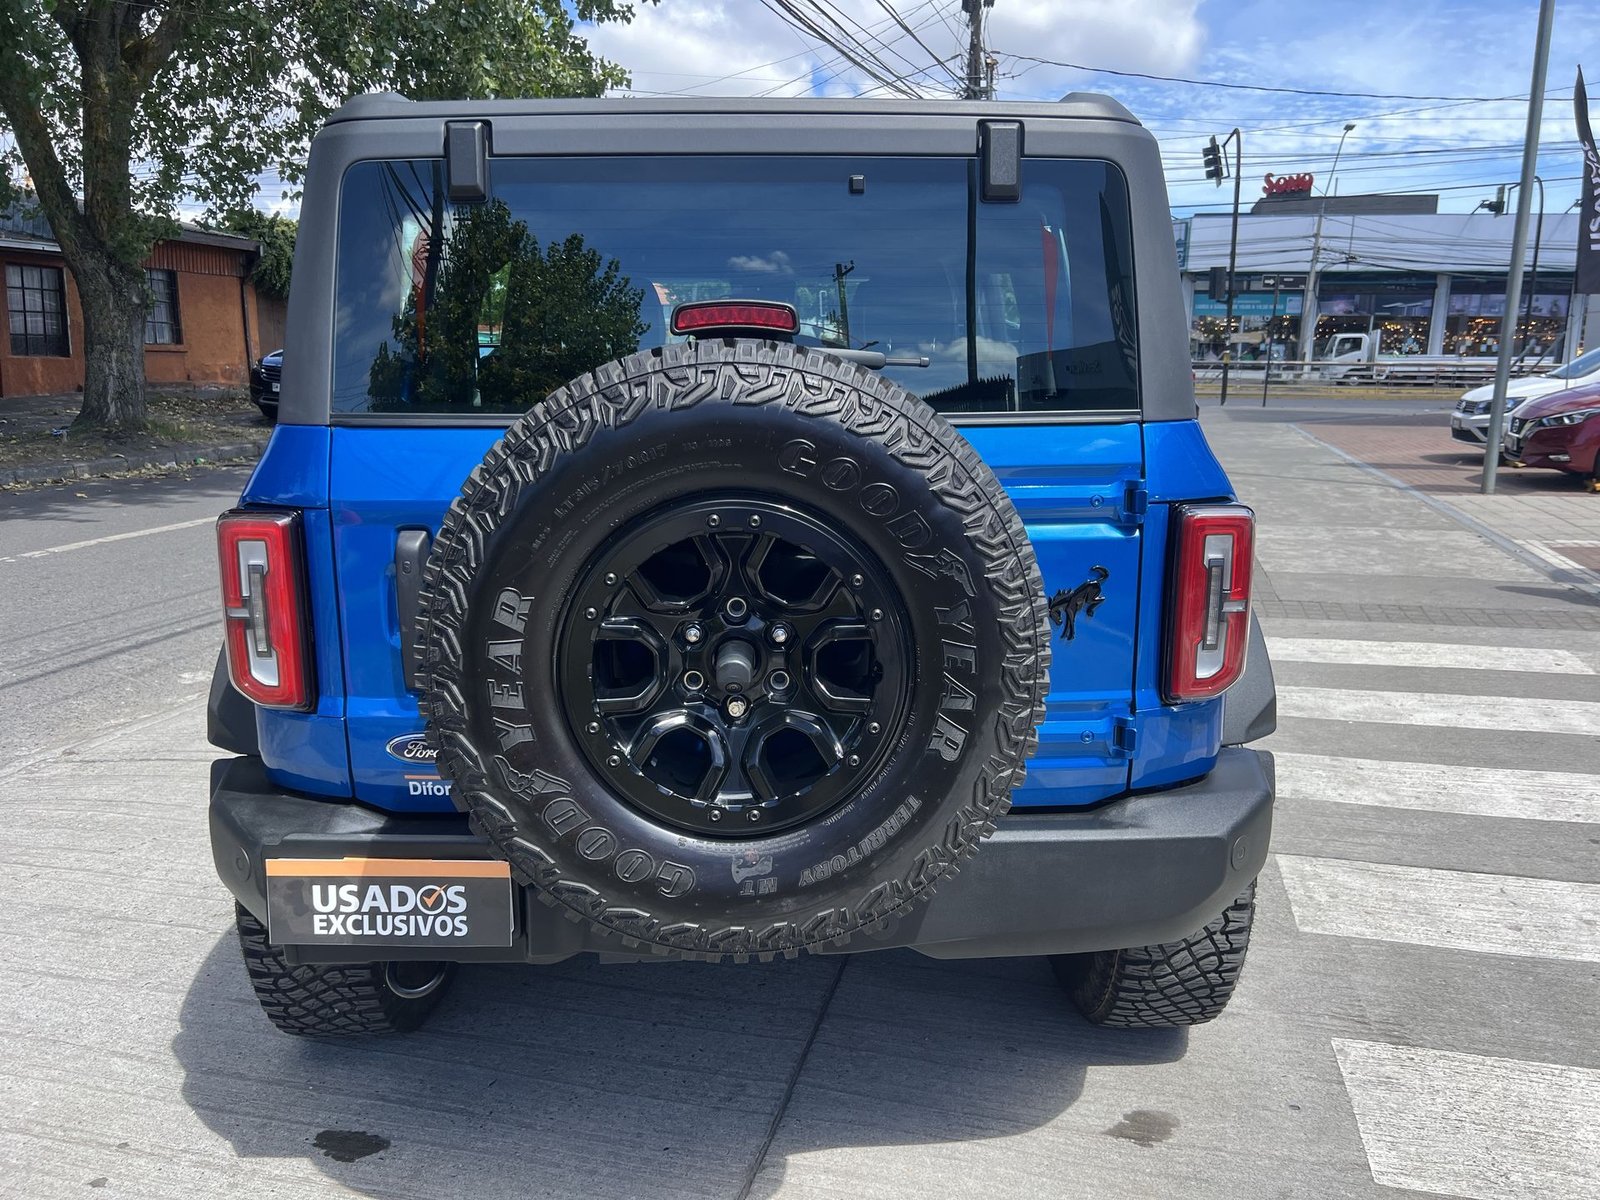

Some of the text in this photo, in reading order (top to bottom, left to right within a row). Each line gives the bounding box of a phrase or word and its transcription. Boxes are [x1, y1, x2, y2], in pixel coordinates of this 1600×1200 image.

[408, 781, 452, 796] Difor
[798, 794, 923, 887] TERRITORY
[311, 883, 468, 915] USADOS
[312, 914, 469, 937] EXCLUSIVOS
